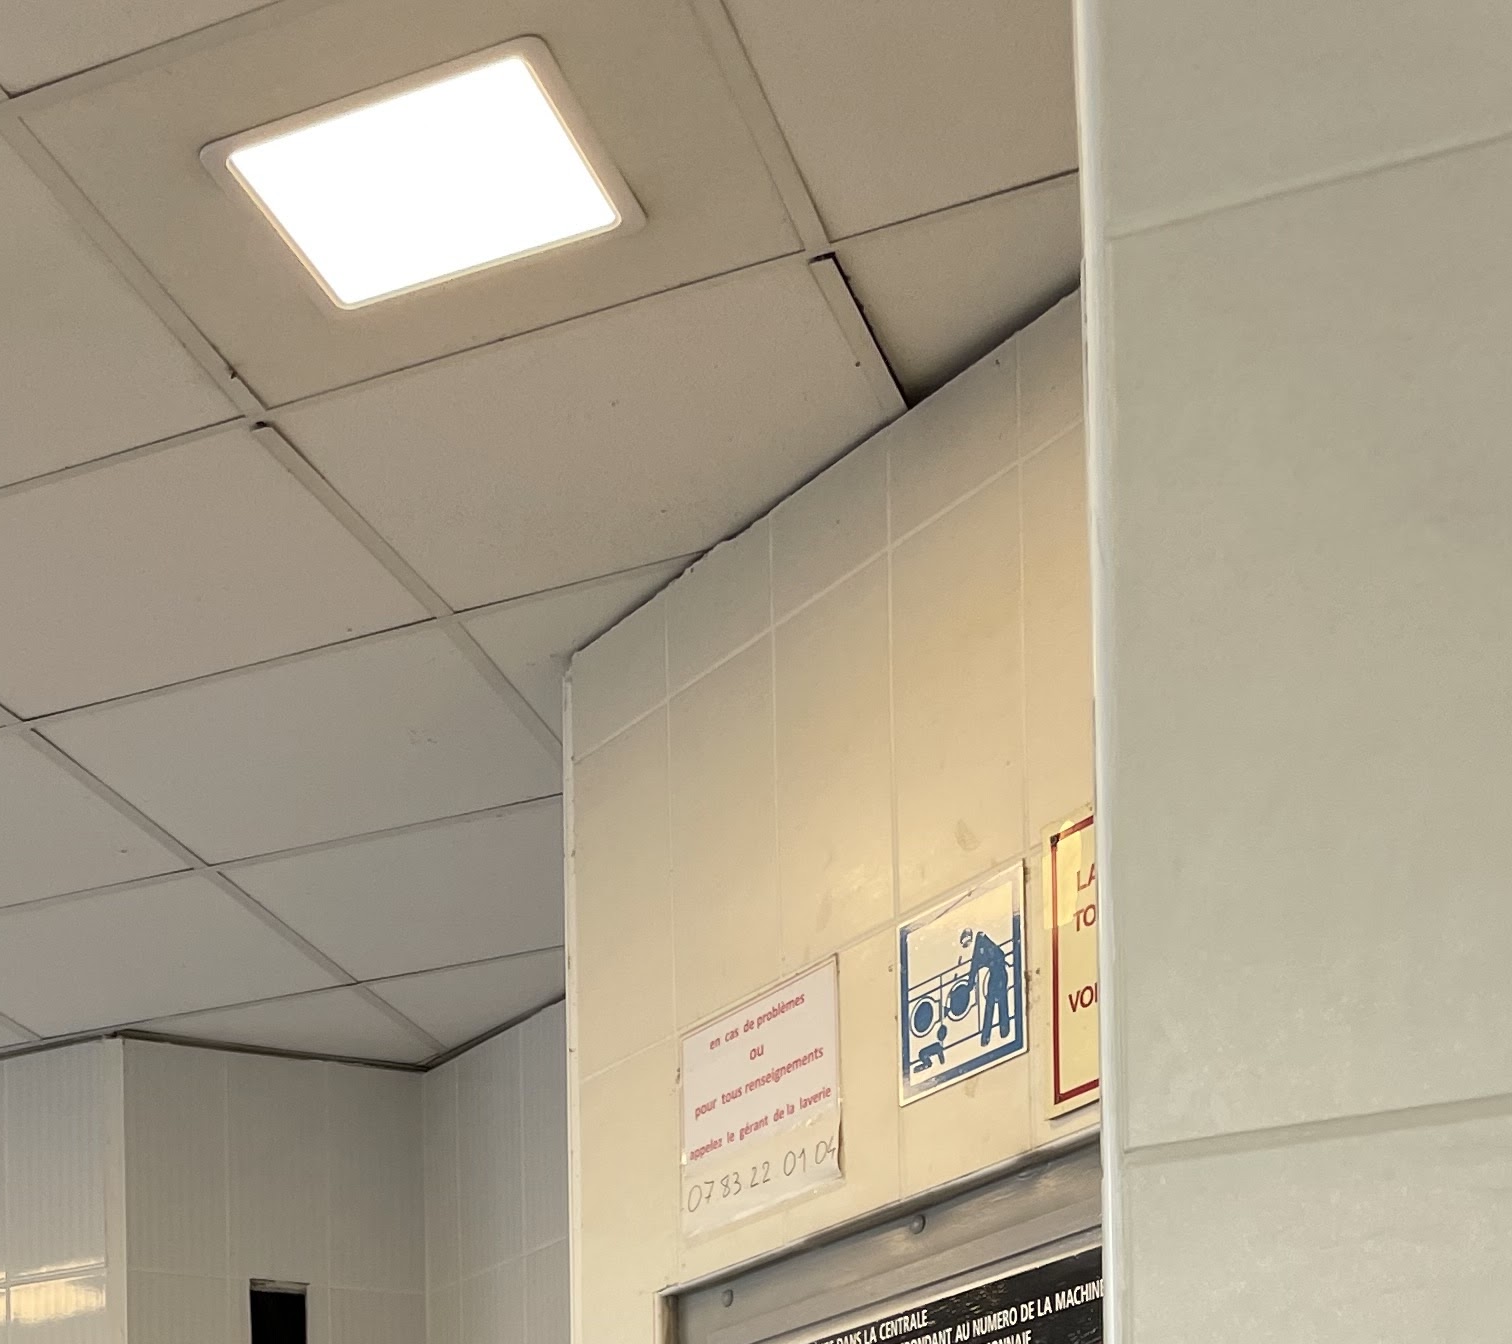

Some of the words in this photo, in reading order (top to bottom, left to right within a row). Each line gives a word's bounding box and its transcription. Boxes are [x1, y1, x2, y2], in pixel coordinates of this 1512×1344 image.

[709, 1037, 721, 1050] en
[724, 1027, 739, 1042] cas
[743, 1019, 755, 1033] de
[756, 993, 805, 1029] problèmes
[694, 1098, 717, 1120] pour
[721, 1086, 742, 1105] tous
[744, 1046, 824, 1095] renseignements
[689, 1137, 723, 1161] appelez
[726, 1131, 735, 1144] le
[739, 1115, 769, 1141] gérant
[773, 1108, 785, 1122] de
[786, 1103, 795, 1116] la
[799, 1086, 832, 1110] laverie
[879, 1308, 928, 1341] CENTRALE
[955, 1321, 970, 1344] AU
[972, 1307, 1018, 1338] NUMERO
[1020, 1301, 1035, 1323] DE
[1037, 1295, 1053, 1317] LA
